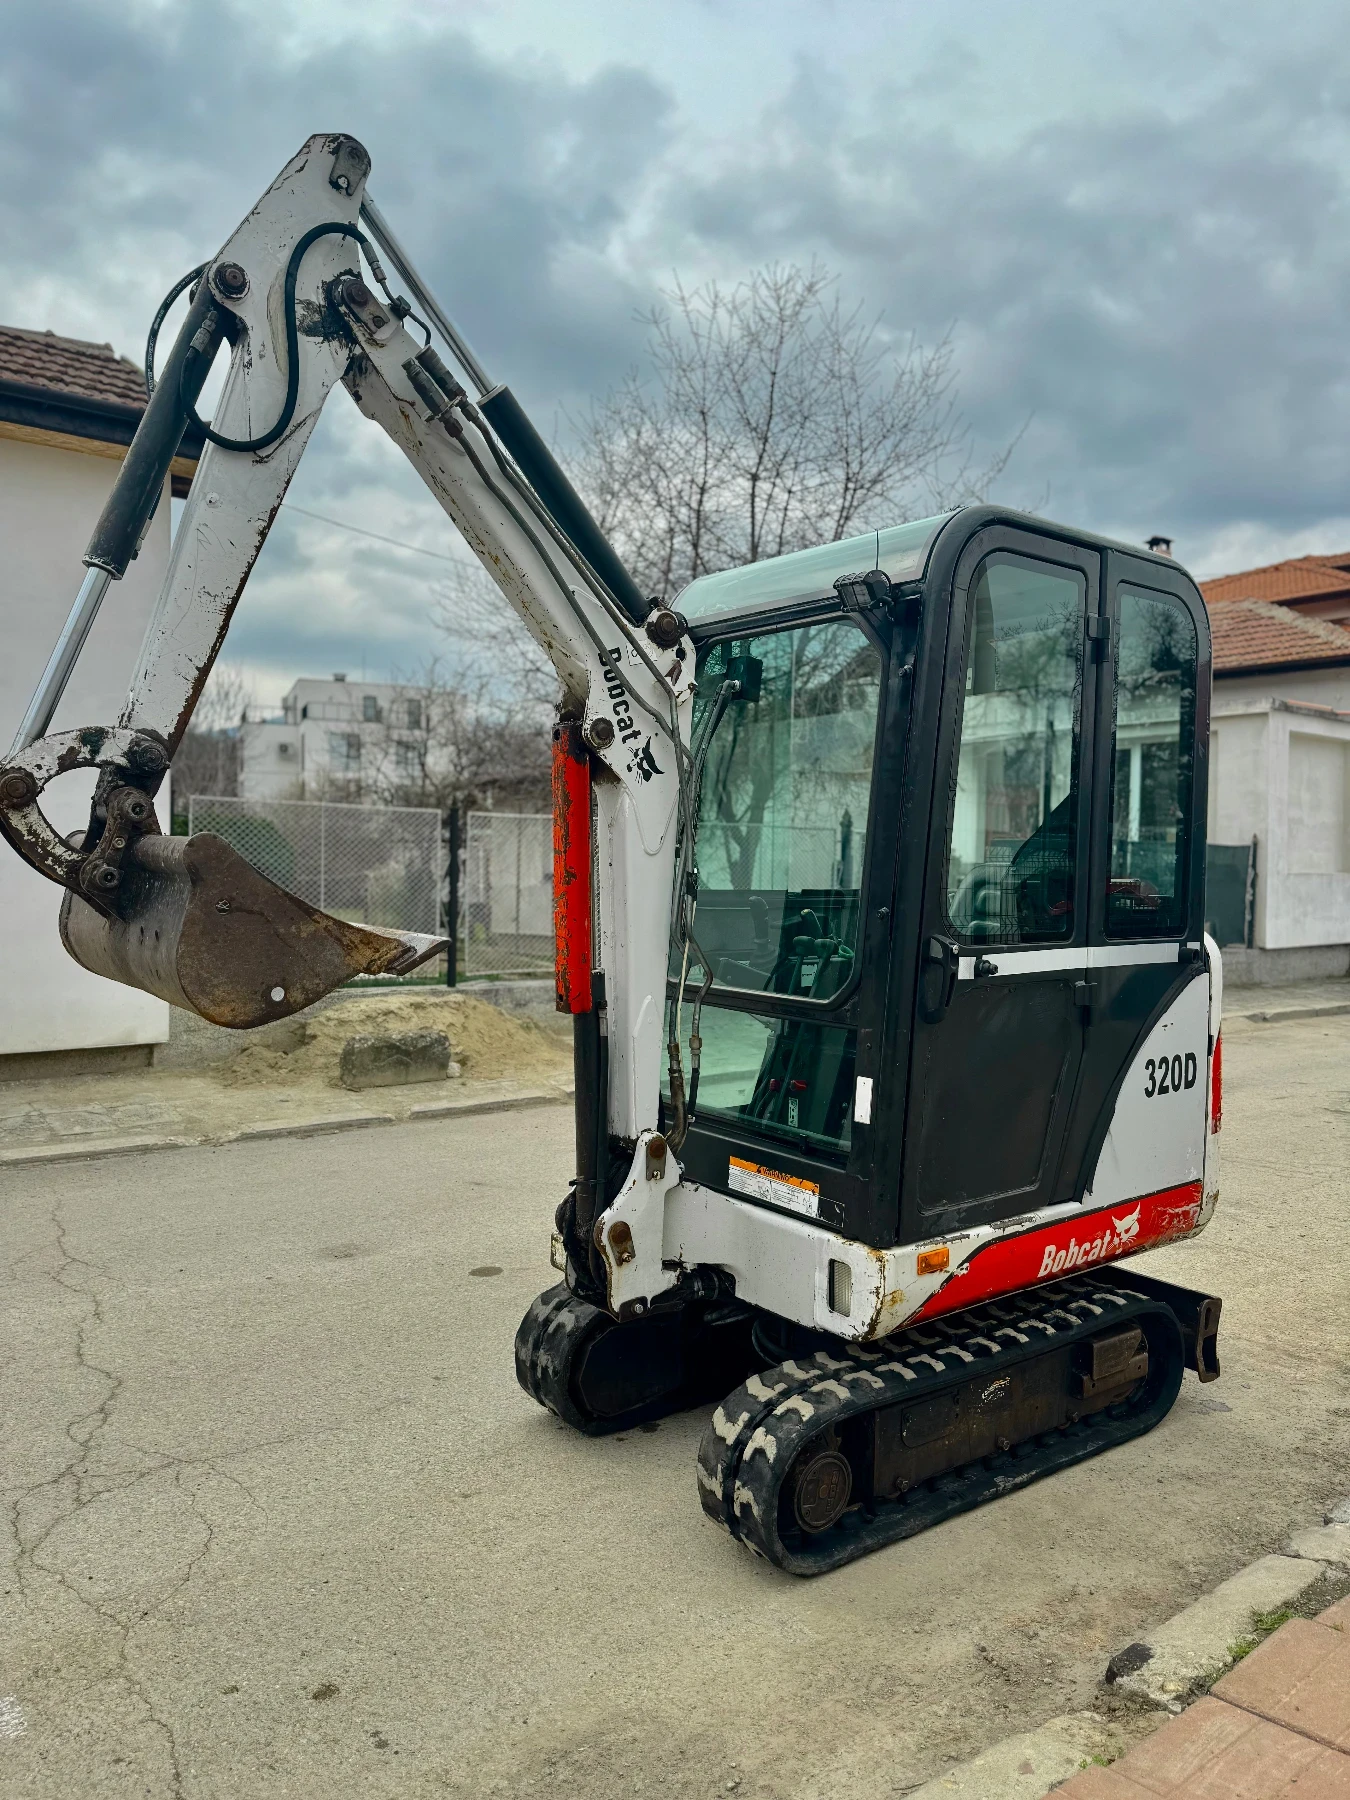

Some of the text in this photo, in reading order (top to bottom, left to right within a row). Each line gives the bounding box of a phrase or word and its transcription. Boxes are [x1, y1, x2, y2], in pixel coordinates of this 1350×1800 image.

[597, 646, 642, 745] Bobcat
[1144, 1052, 1197, 1098] 320D
[1037, 1230, 1111, 1278] Bobcat
